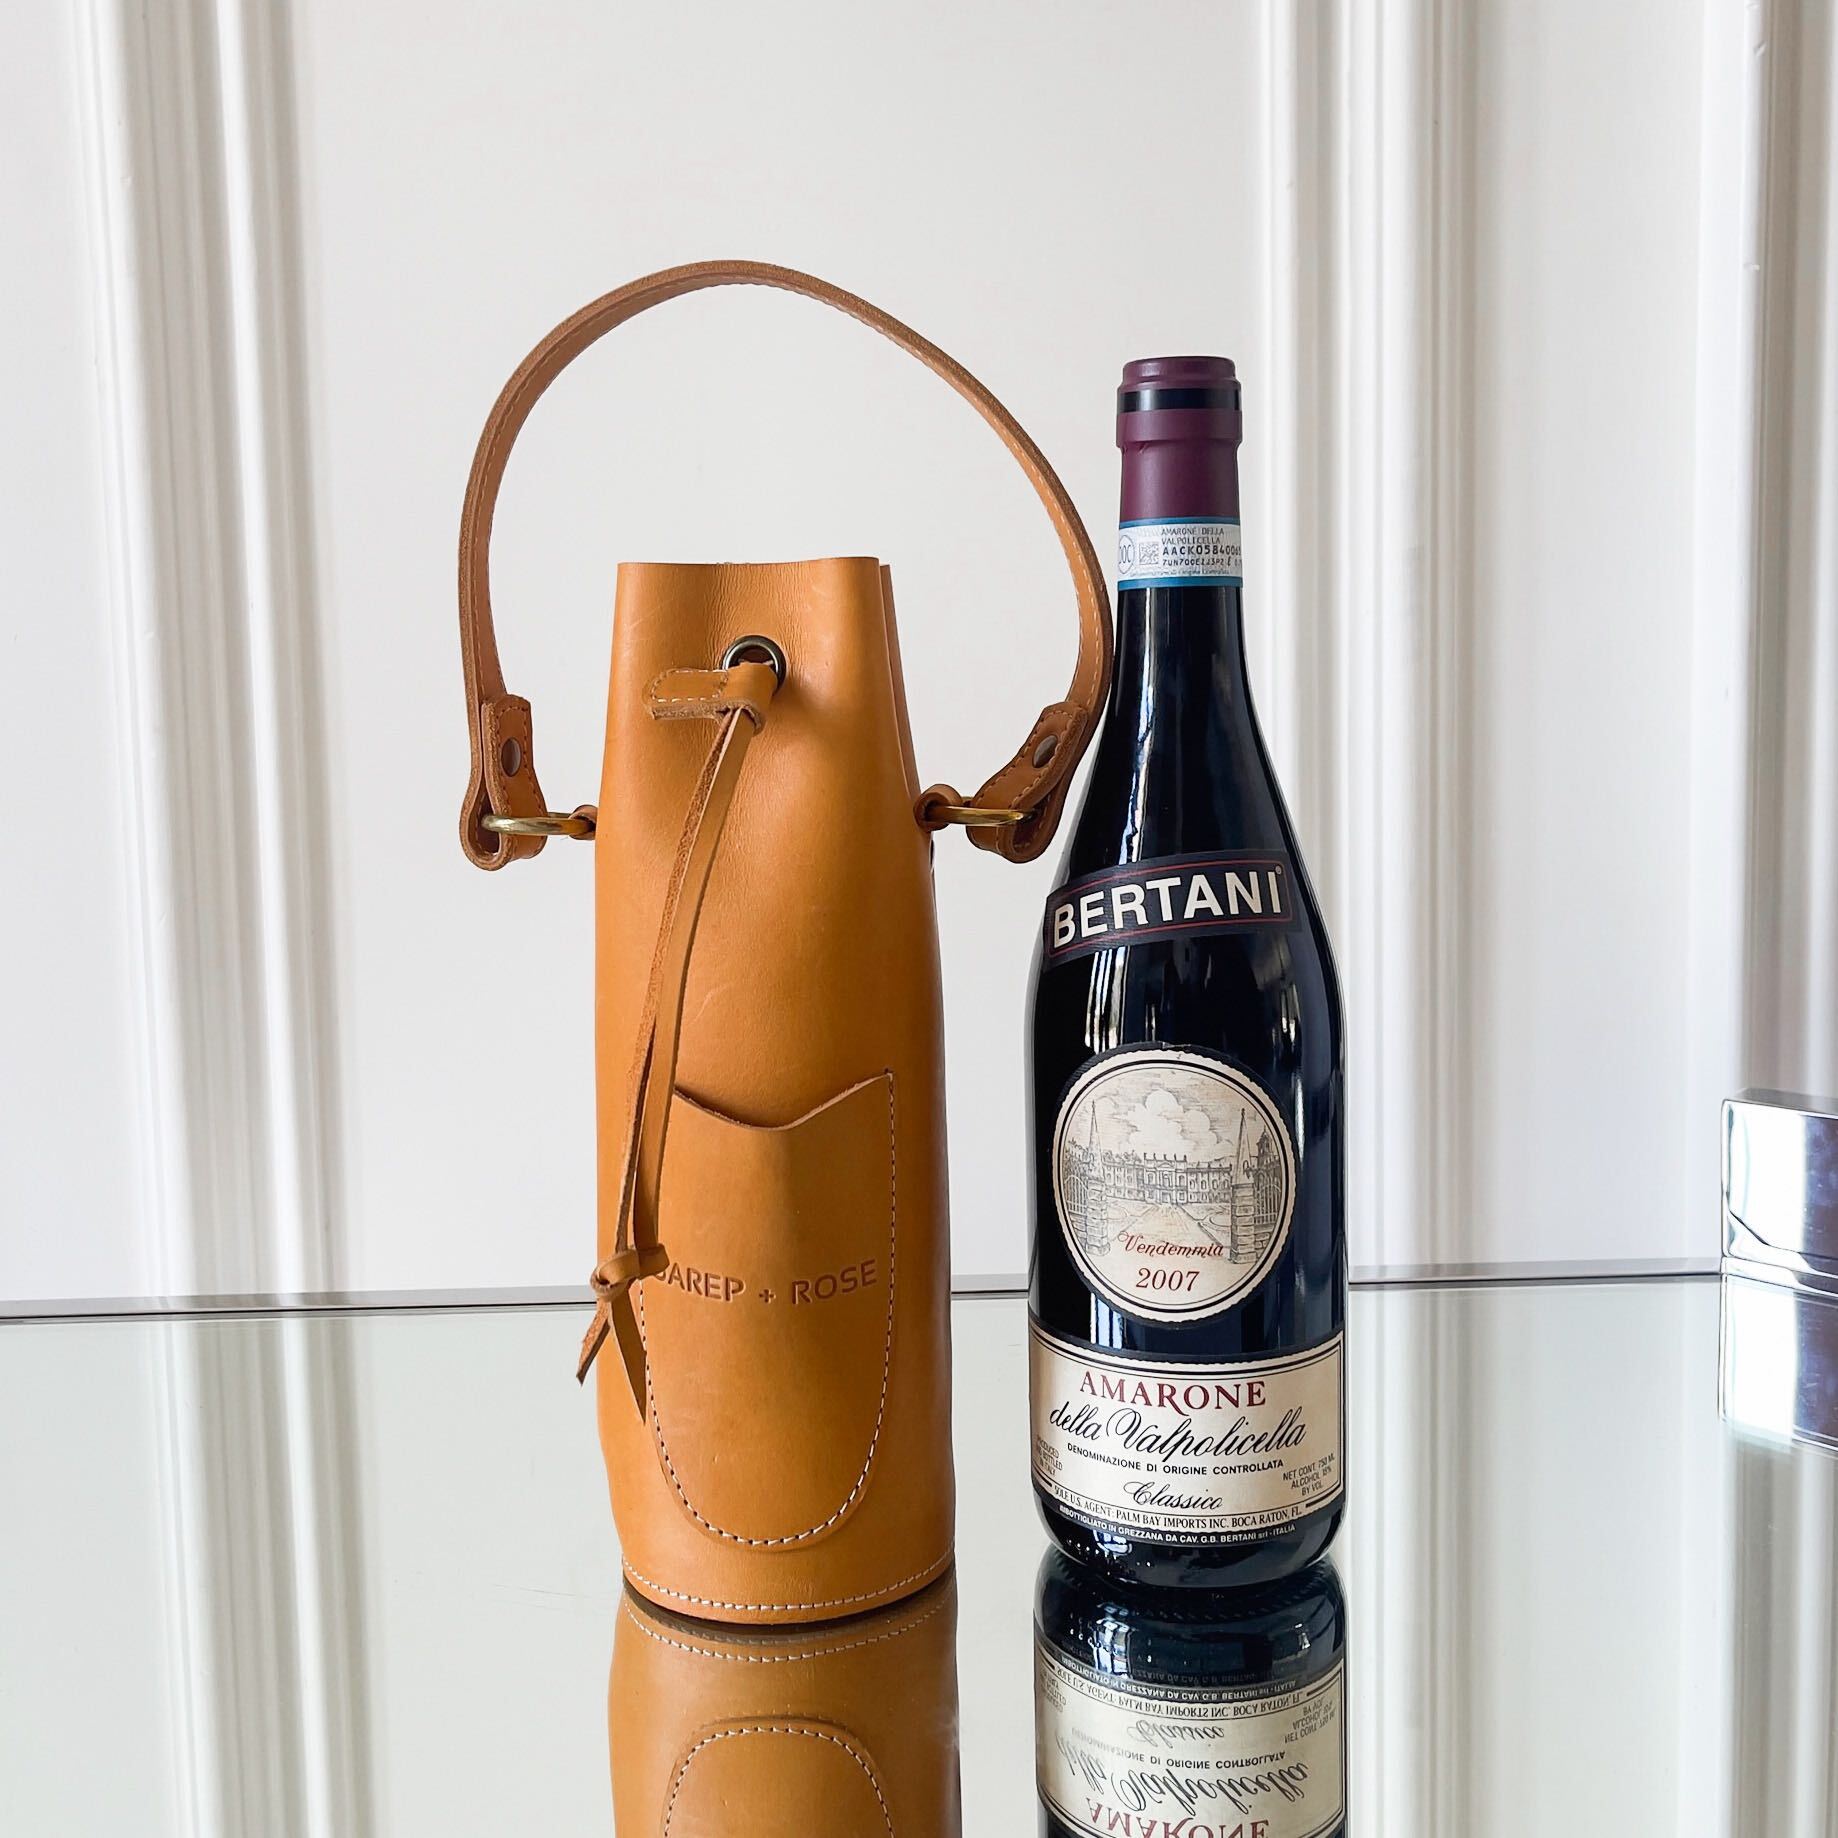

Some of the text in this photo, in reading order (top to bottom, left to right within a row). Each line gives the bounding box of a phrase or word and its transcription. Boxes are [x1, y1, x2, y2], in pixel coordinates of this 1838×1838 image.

[1054, 871, 1282, 949] BERTANI
[1118, 1231, 1224, 1258] Vendemmia
[791, 1258, 878, 1304] ROSE
[1136, 1268, 1200, 1291] 2007
[1079, 1370, 1266, 1416] AMARONE
[1049, 1401, 1307, 1463] della Valpolicella
[1067, 1442, 1284, 1475] DENOMINAZIONE DI ORIGINE CONTROLLATA
[1282, 1468, 1297, 1481] NET
[1291, 1471, 1320, 1489] ALCOHOL
[1123, 1481, 1224, 1510] Classico
[1301, 1486, 1310, 1496] BY
[1116, 1510, 1141, 1523] PALM
[1142, 1513, 1161, 1526] BAY
[1163, 1517, 1207, 1529] IMPORTS
[1209, 1518, 1230, 1529] INC.
[1231, 1516, 1258, 1527] BOCA
[1108, 1524, 1117, 1533] IN
[1118, 1527, 1164, 1541] GREZZANA
[1165, 1532, 1178, 1543] DA
[1180, 1535, 1199, 1544] CAV.
[1220, 1532, 1257, 1543] BERTANI
[1273, 1523, 1296, 1537] ITALIA
